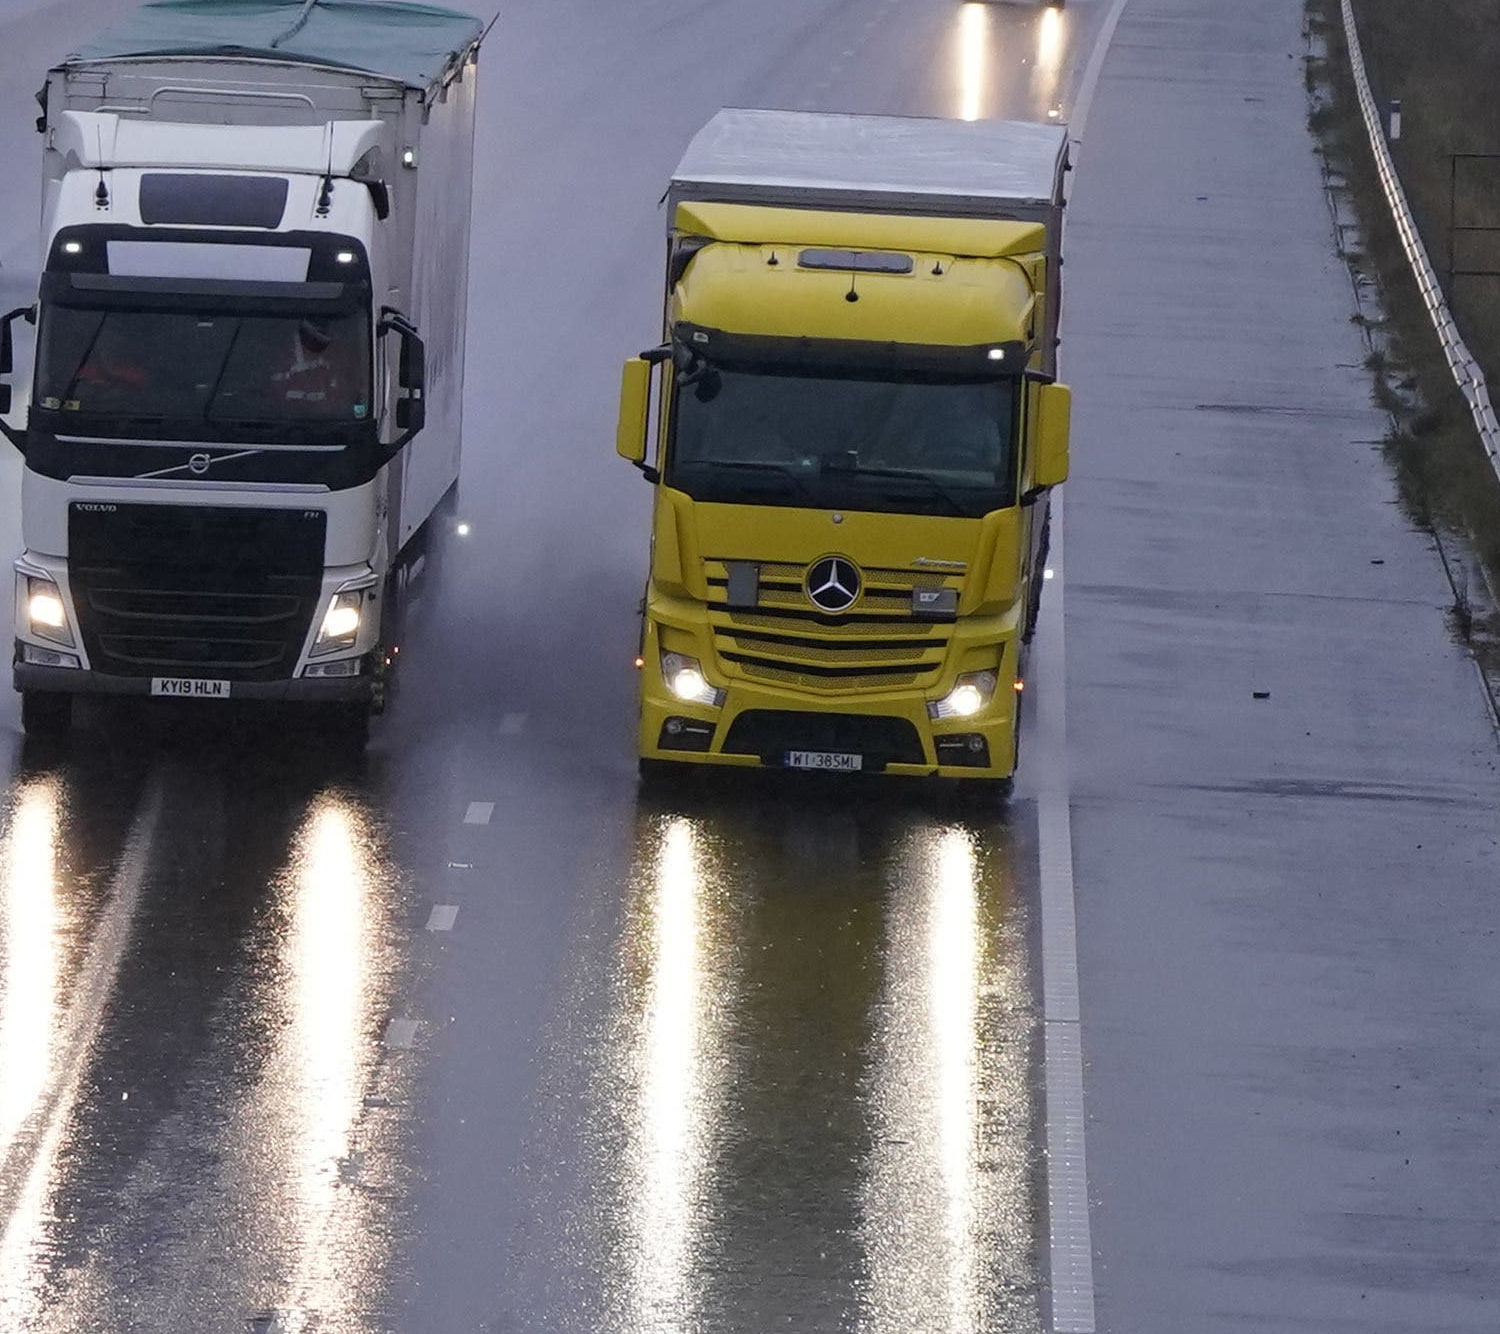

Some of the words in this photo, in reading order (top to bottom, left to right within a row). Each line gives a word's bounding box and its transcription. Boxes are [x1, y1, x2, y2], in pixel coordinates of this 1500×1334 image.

[75, 503, 117, 512] VOLVO
[161, 679, 192, 693] KY19
[194, 681, 222, 695] HLN
